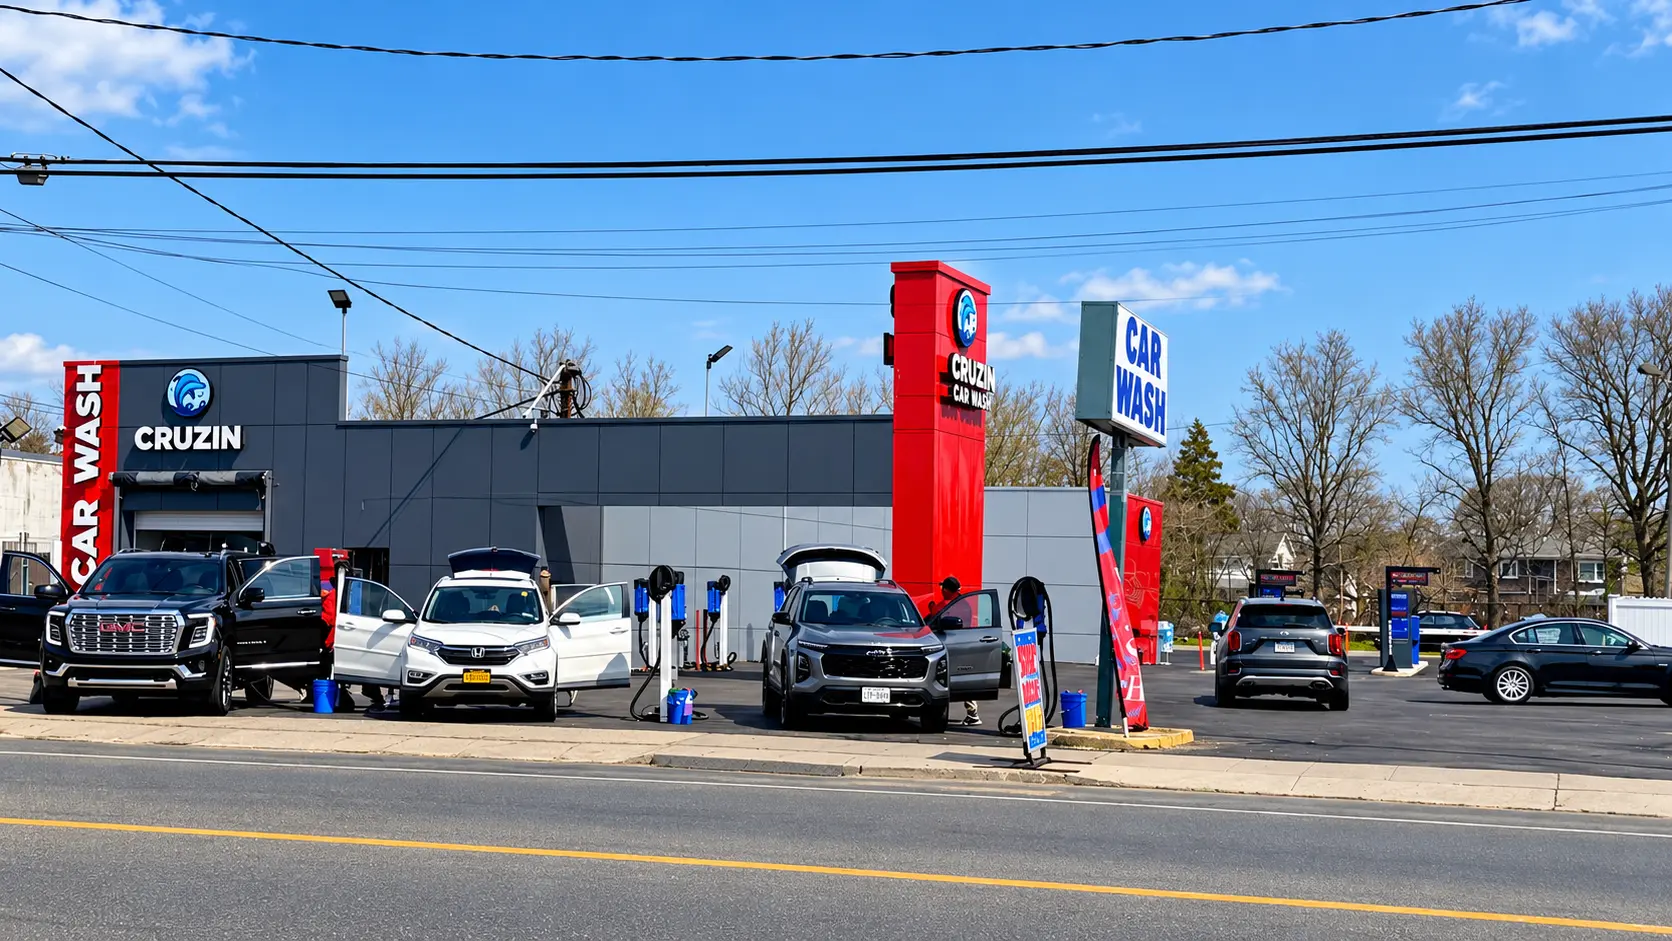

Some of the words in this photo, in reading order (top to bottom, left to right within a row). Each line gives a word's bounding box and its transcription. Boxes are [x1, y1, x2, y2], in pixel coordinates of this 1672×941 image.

[952, 353, 996, 393] CRUZIN
[1126, 316, 1161, 379] CAR
[953, 384, 970, 405] CAR
[971, 389, 992, 411] WASH
[1116, 364, 1166, 436] WASH
[74, 364, 102, 484] WASH
[134, 425, 242, 451] CRUZIN
[70, 499, 99, 585] CAR
[99, 620, 145, 632] GMC
